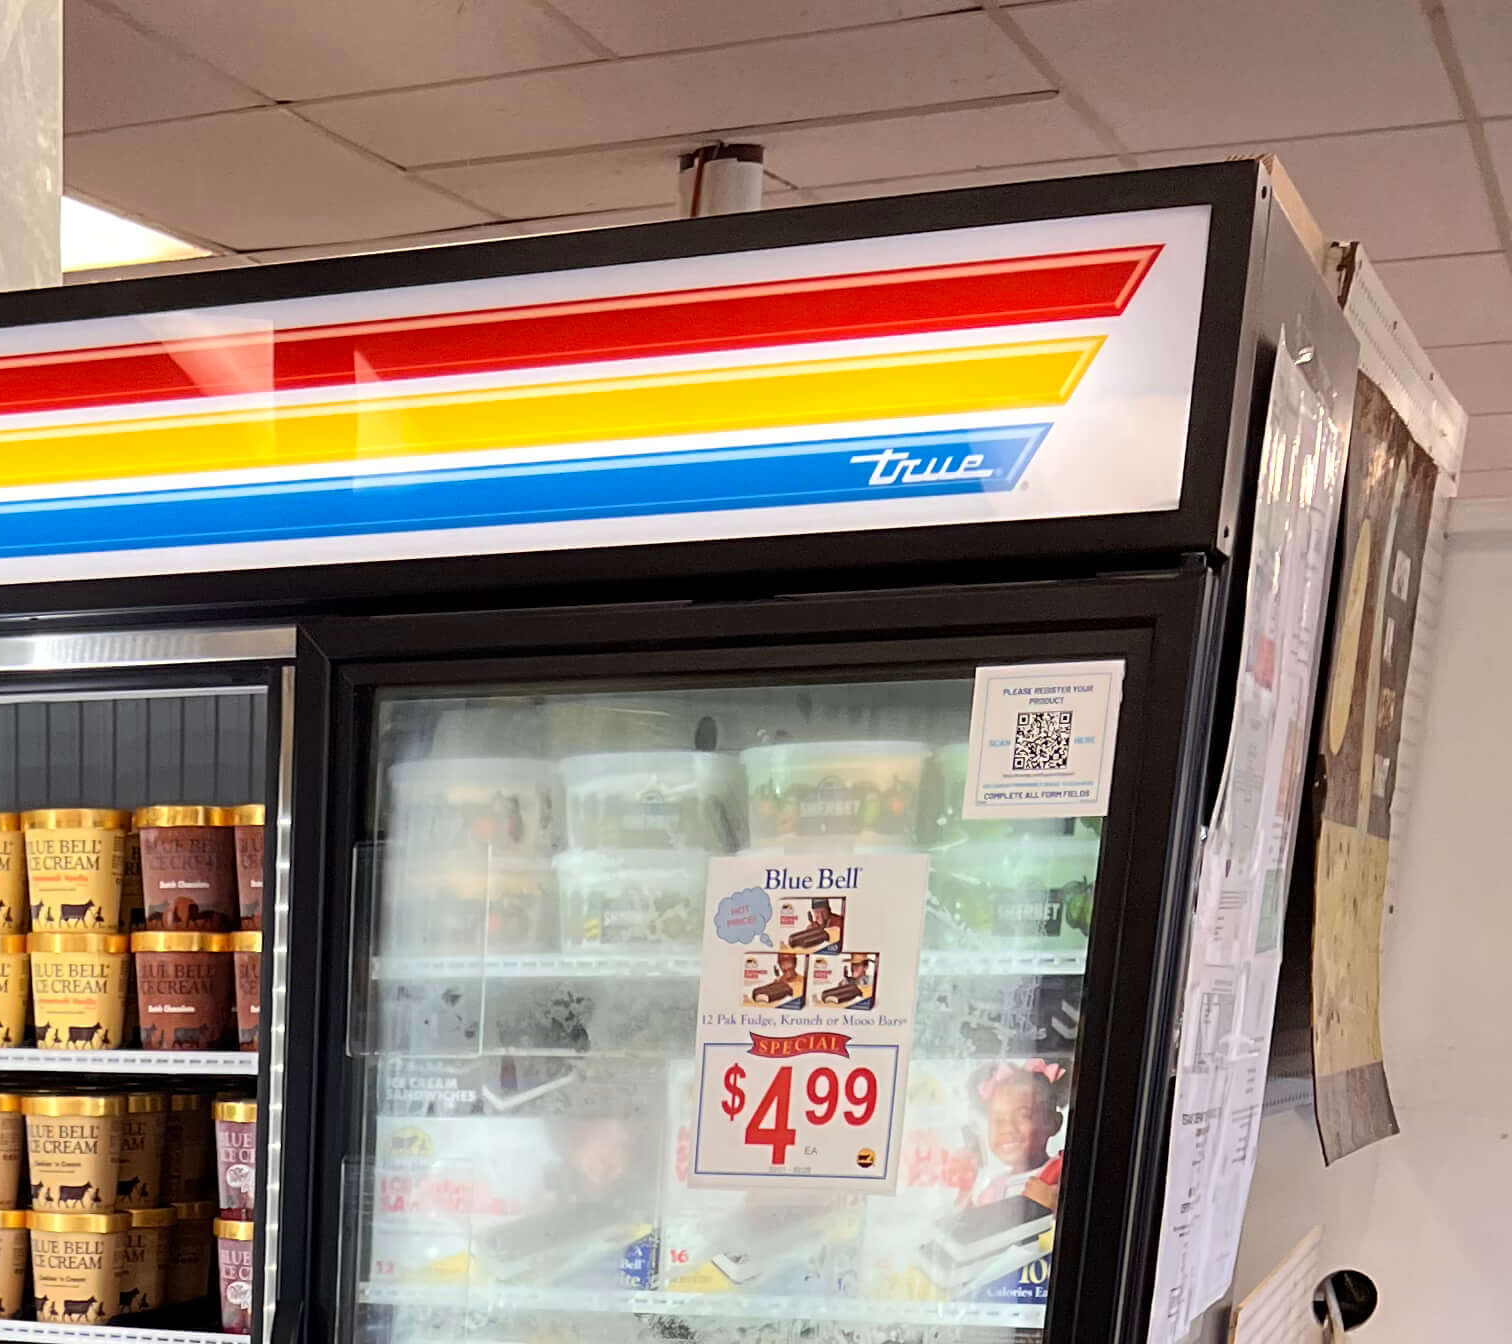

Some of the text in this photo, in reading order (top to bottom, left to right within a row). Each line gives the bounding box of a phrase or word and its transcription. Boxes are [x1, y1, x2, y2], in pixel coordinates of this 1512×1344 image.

[850, 449, 994, 486] true
[1003, 687, 1032, 696] PLEASE
[984, 791, 1023, 800] COMPLETE
[1025, 791, 1039, 799] ALL
[1063, 789, 1090, 797] FIELDS
[59, 839, 103, 854] BELL
[42, 855, 101, 872] CREAM
[764, 867, 862, 890] Blue Bell
[68, 963, 110, 978] BELL
[51, 979, 108, 994] CREAM
[702, 1015, 713, 1025] 12
[717, 1014, 737, 1025] Pak
[780, 1014, 823, 1026] Krunch
[826, 1017, 840, 1026] or
[759, 1035, 840, 1055] SPECIAL
[59, 1125, 99, 1139] BELL
[44, 1140, 98, 1154] CREAM
[64, 1241, 104, 1254] BELL
[48, 1255, 102, 1270] CREAM
